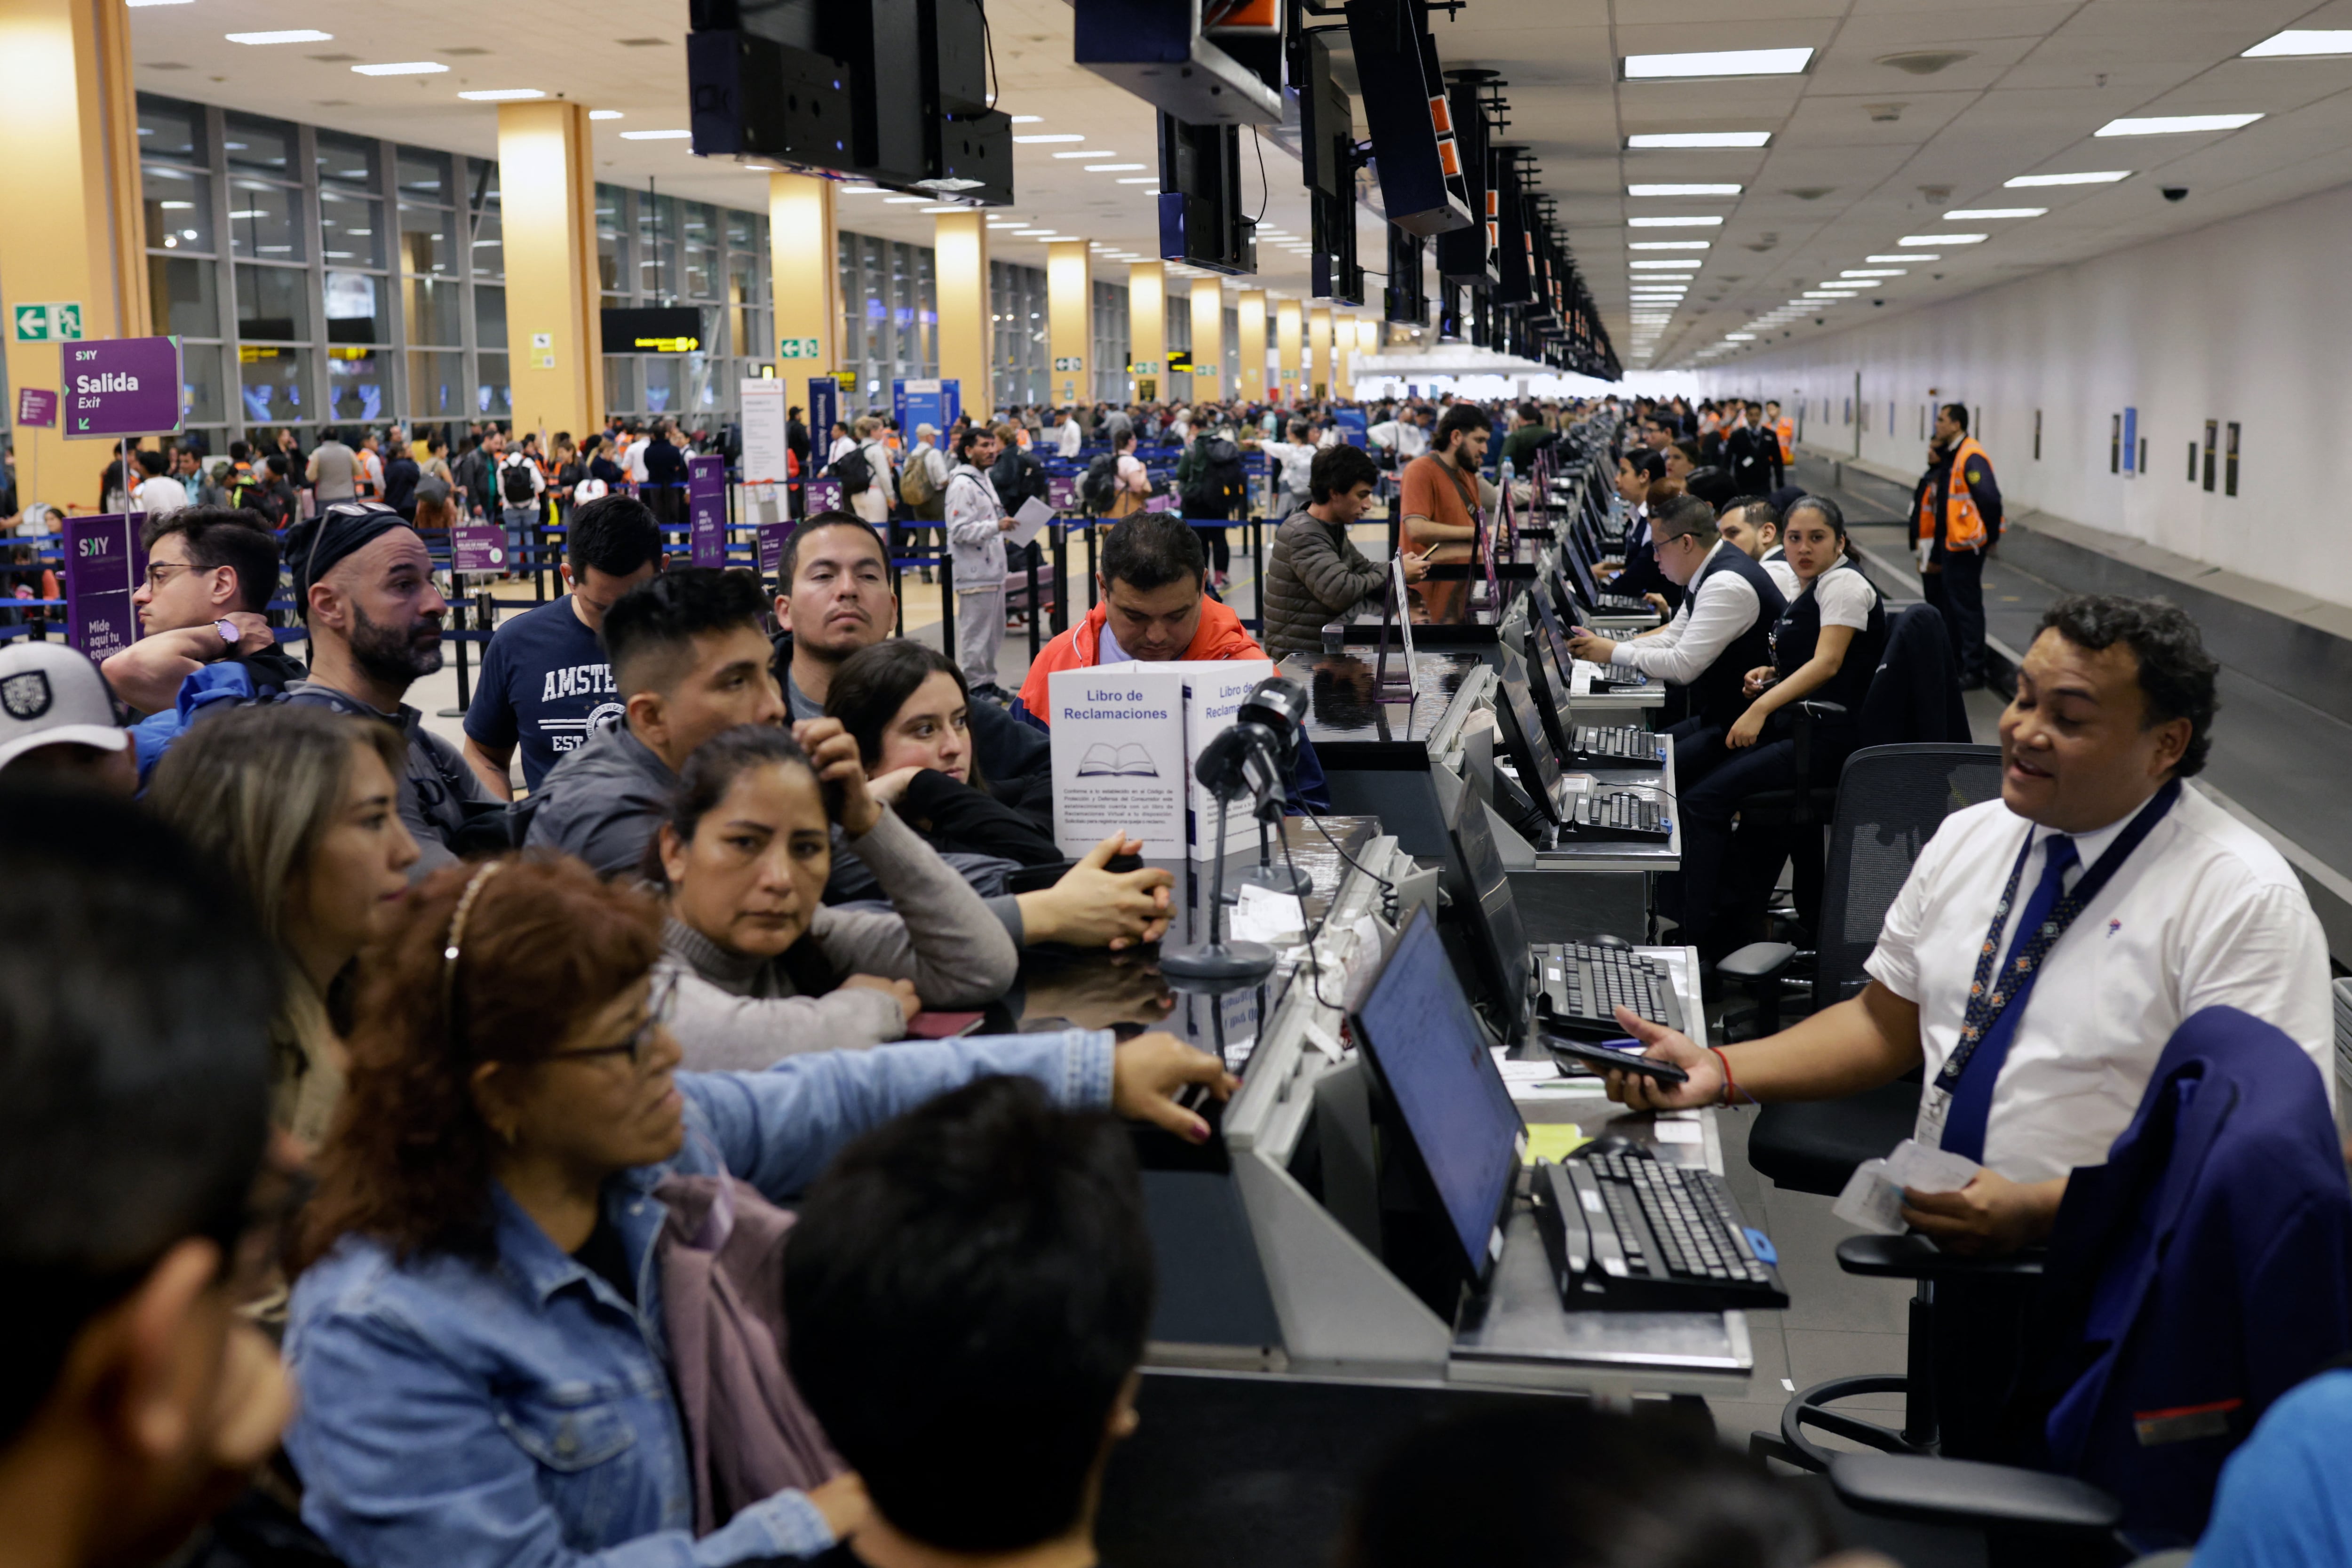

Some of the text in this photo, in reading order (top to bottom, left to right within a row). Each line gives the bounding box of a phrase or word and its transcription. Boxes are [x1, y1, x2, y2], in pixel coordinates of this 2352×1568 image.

[76, 350, 97, 361] SKY
[77, 372, 138, 394] Salida
[78, 396, 101, 409] Exit
[79, 536, 109, 557] SKY
[89, 619, 110, 634] Mide
[90, 631, 119, 648] aquí tu
[541, 664, 618, 702] AMSTE
[1220, 682, 1253, 698] Libro de
[1087, 690, 1143, 701] Libro de
[1064, 708, 1168, 719] Reclamaciones
[1206, 704, 1240, 719] Reclama
